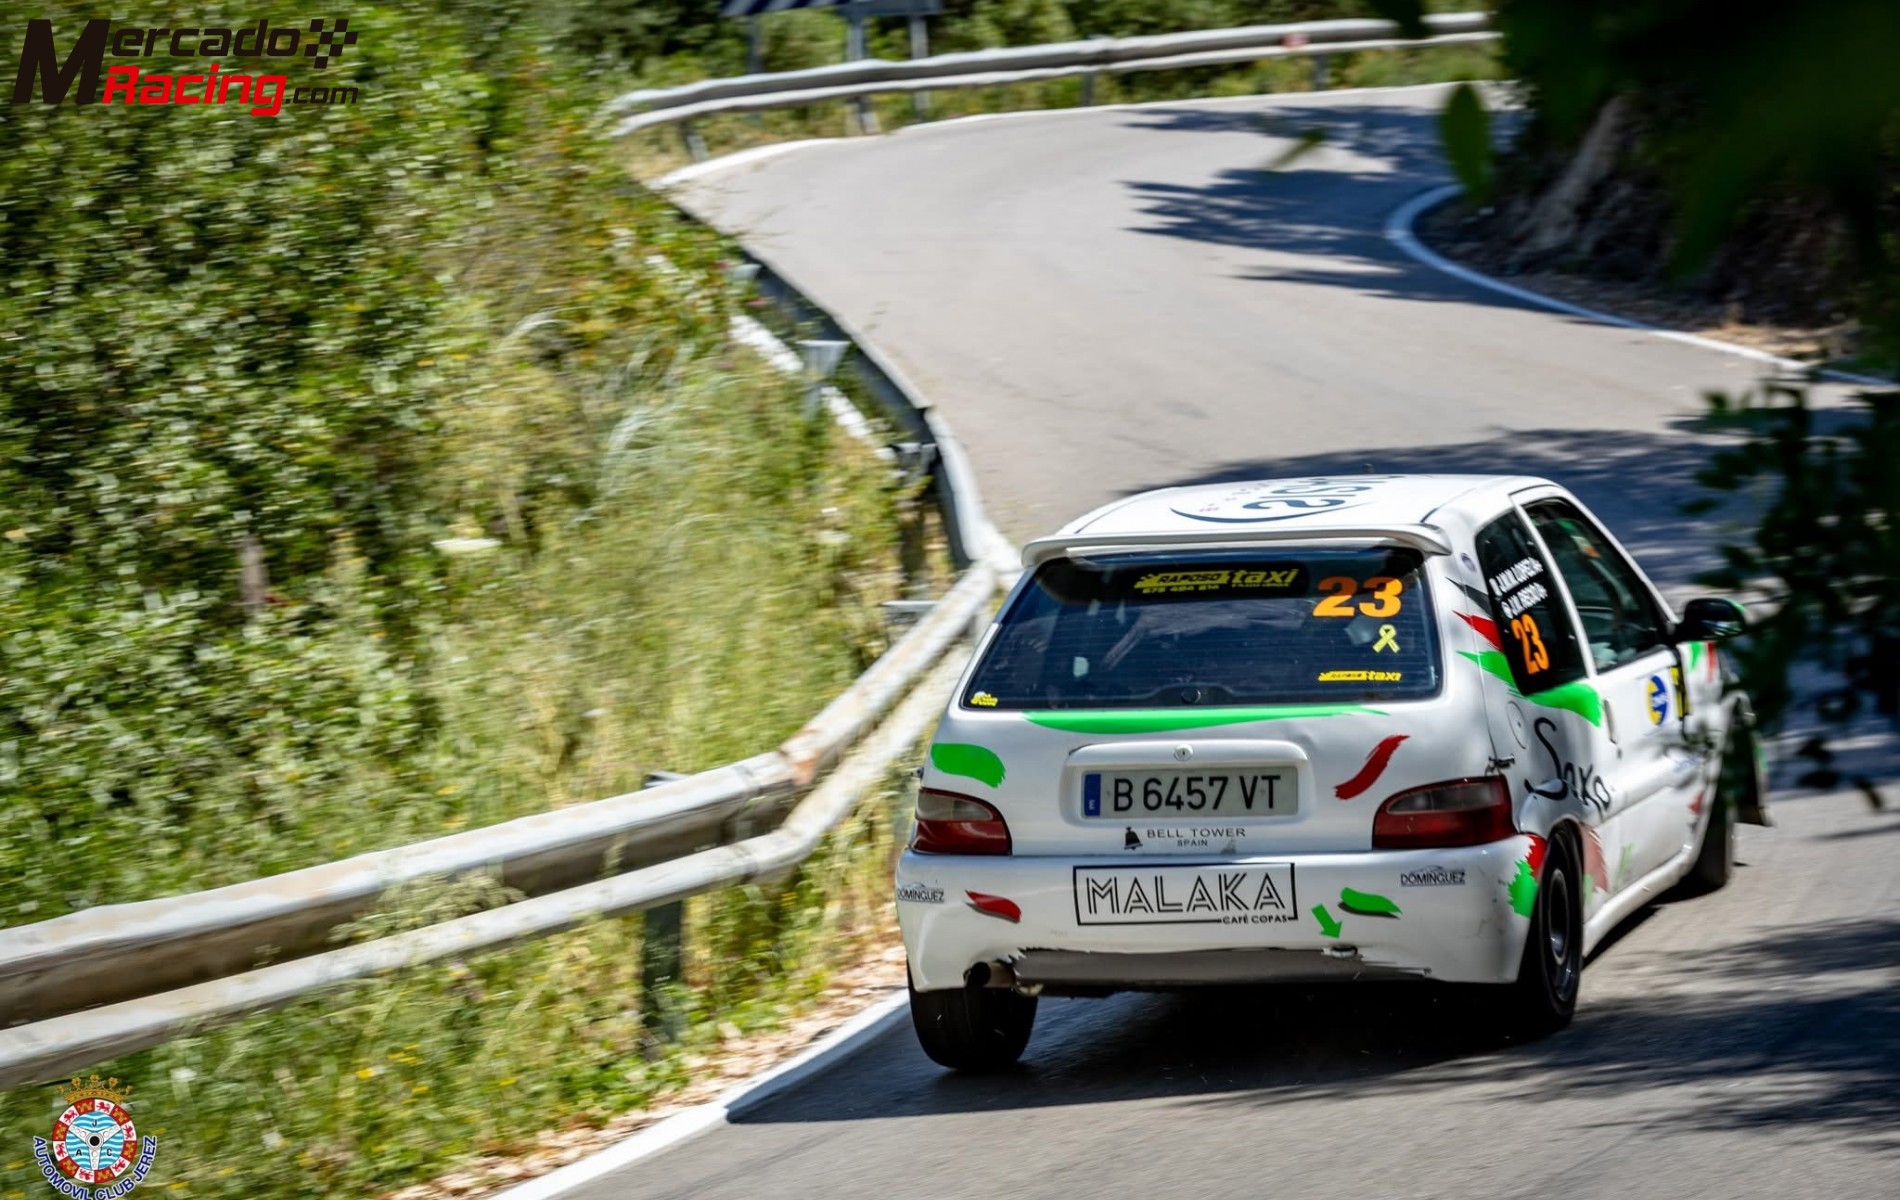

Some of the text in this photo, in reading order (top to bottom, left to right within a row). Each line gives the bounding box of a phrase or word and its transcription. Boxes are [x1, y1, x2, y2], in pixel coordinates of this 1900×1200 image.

[1232, 569, 1299, 584] taxi
[1312, 576, 1403, 618] 23
[1511, 613, 1549, 674] 23
[1113, 775, 1281, 812] B 6457 VT
[1146, 827, 1246, 839] BELL TOWER
[1176, 838, 1208, 848] SPAIN
[1086, 872, 1286, 915] MALAKA
[1222, 914, 1288, 926] CAFÉ COPAS
